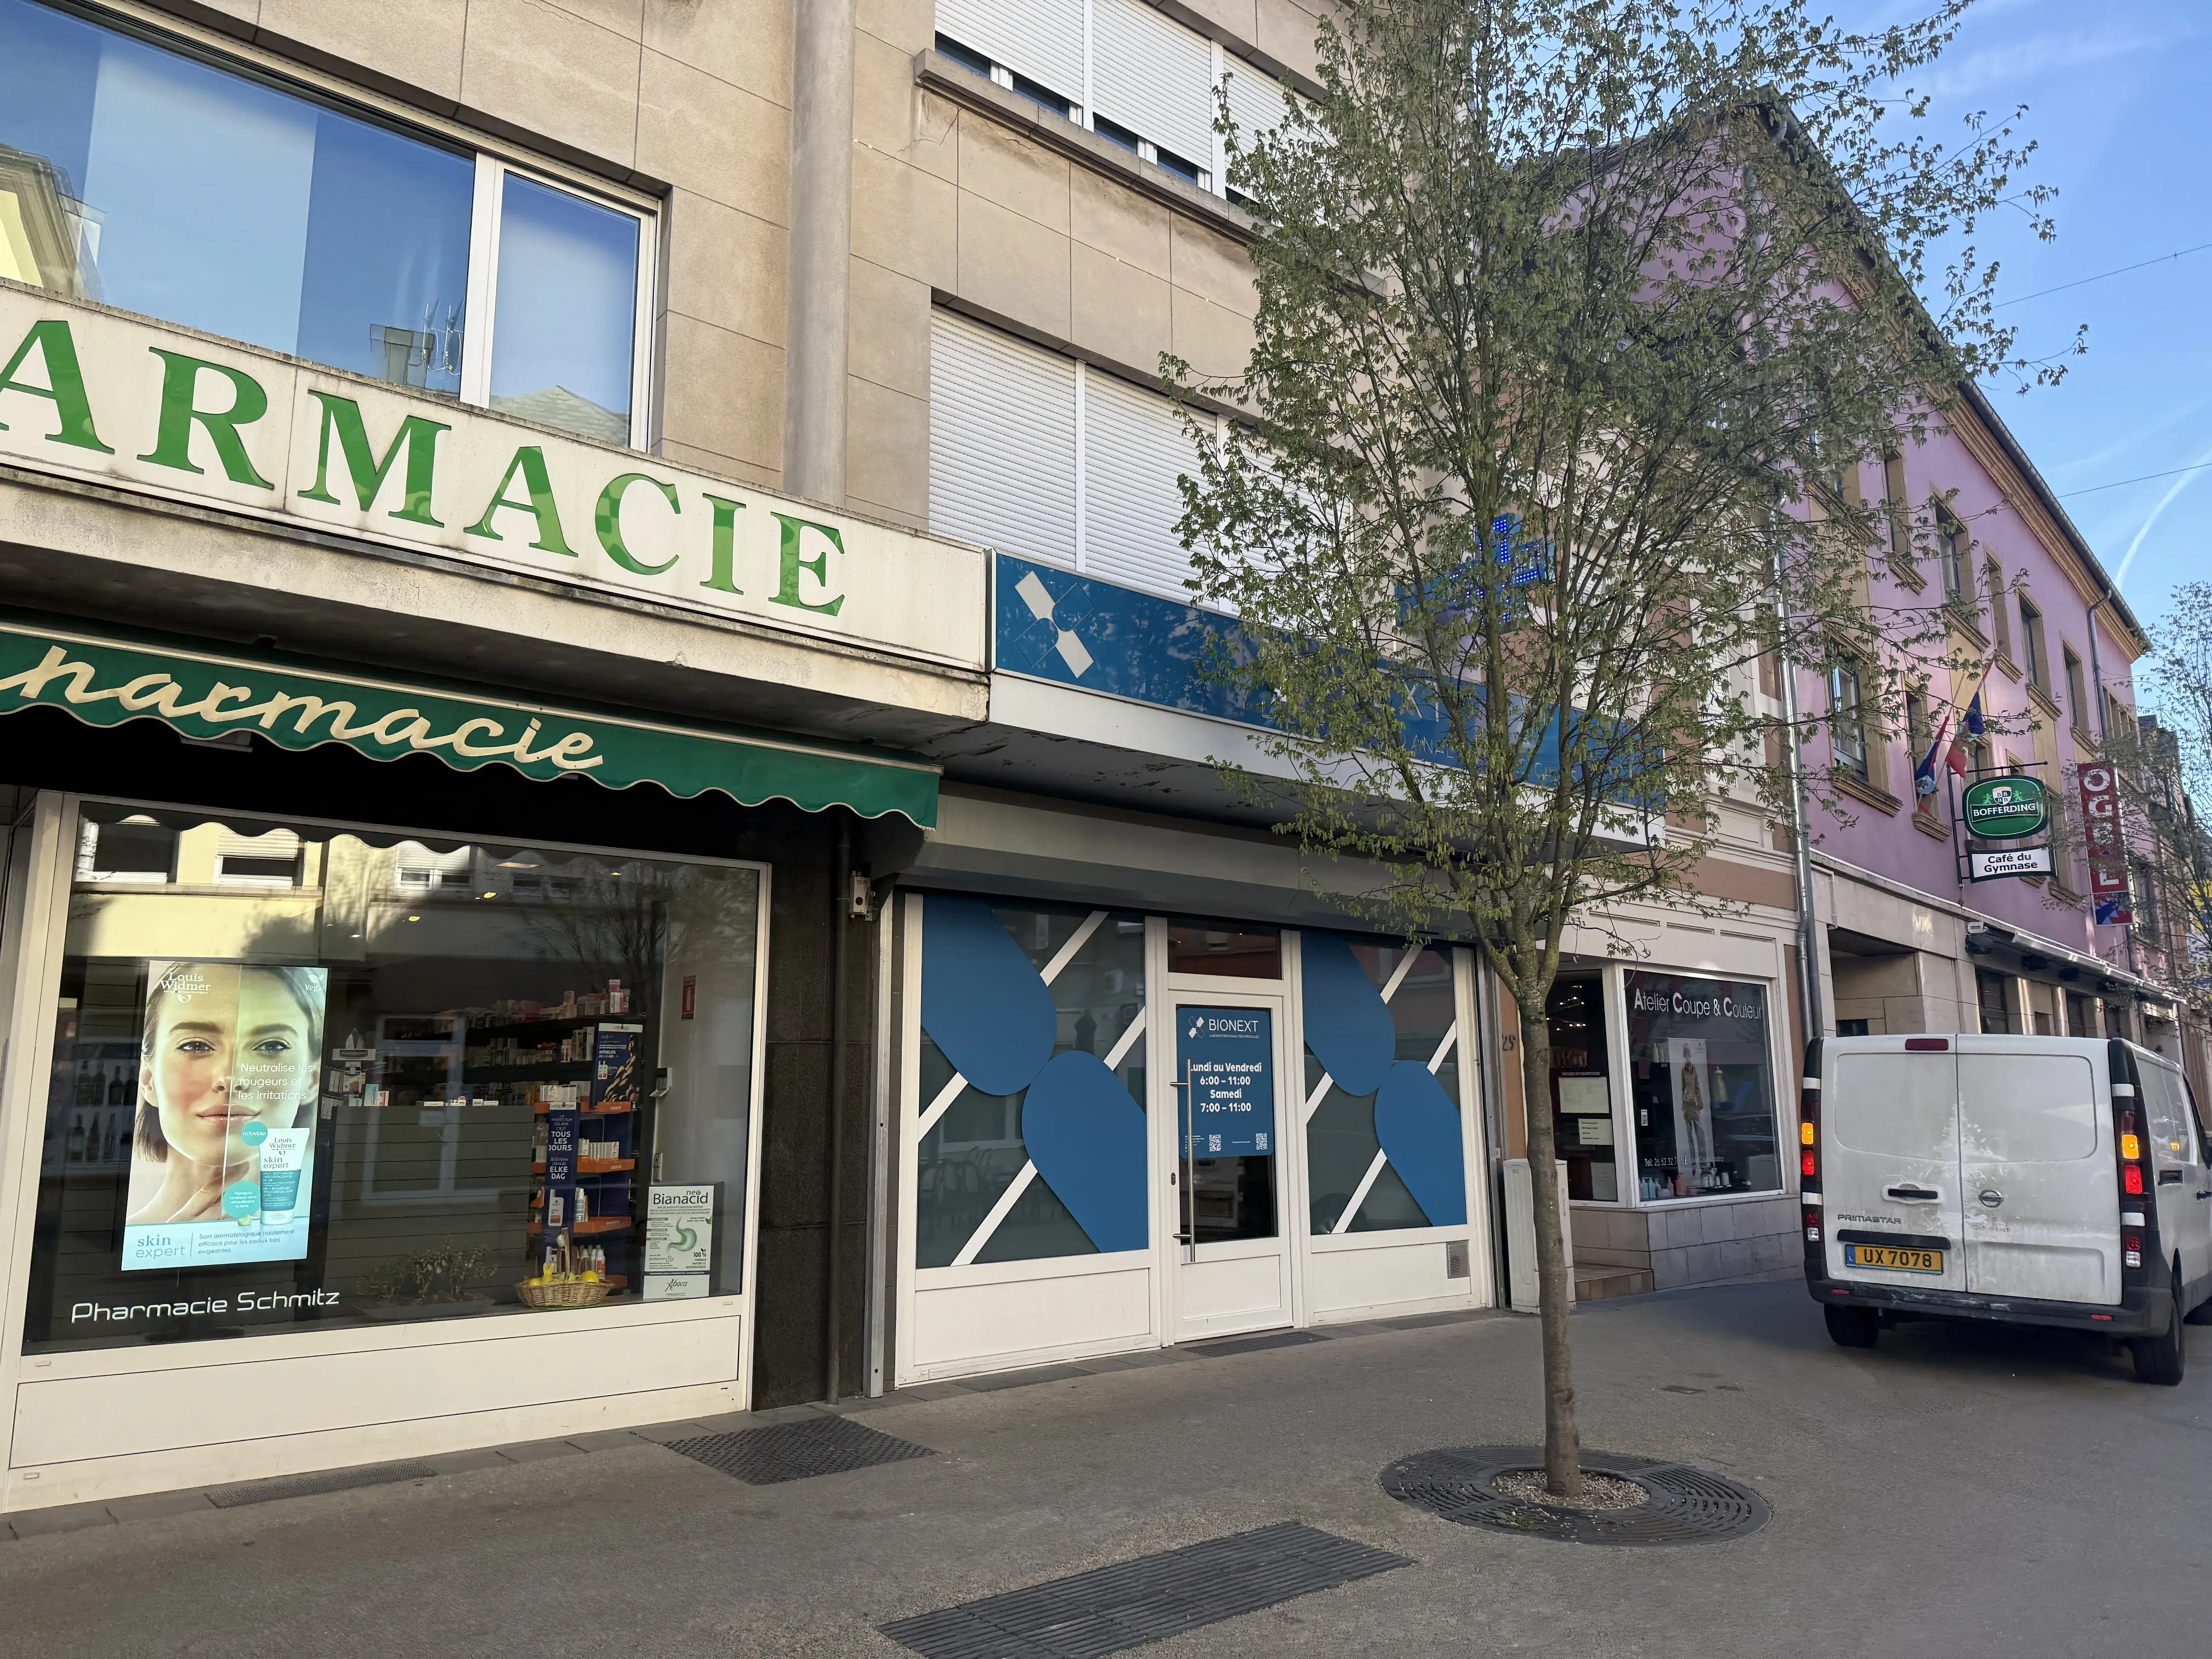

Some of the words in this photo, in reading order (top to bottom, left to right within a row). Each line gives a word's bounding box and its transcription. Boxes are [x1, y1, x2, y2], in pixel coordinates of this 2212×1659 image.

[1973, 804, 2035, 817] BOFFERDING
[1988, 854, 2013, 863] Café
[1984, 862, 2037, 873] Gymnase
[168, 972, 203, 982] Louis
[160, 981, 211, 991] Widmer
[1634, 989, 1669, 1012] Atelier
[1673, 992, 1710, 1018] Coupe
[1714, 999, 1721, 1015] &
[1724, 997, 1761, 1019] Couleur
[1209, 1019, 1258, 1032] BIONEXT
[241, 1063, 295, 1072] Neutralise
[299, 1063, 313, 1072] les
[1225, 1062, 1262, 1072] Vendredi
[240, 1079, 287, 1088] rougeurs
[1200, 1076, 1219, 1085] 6:00
[1228, 1077, 1251, 1085] 11:00
[239, 1091, 253, 1099] les
[257, 1091, 306, 1099] irritations
[1210, 1089, 1242, 1099] Samedi
[1200, 1103, 1220, 1112] 7:00
[1229, 1103, 1251, 1112] 11:00
[653, 1192, 708, 1204] Bianacid
[1838, 1214, 1901, 1224] PRIMASTAR
[137, 1235, 171, 1247] skin
[136, 1245, 185, 1259] expert
[1864, 1248, 1884, 1264] UX
[1889, 1250, 1932, 1268] 7078
[665, 1278, 688, 1291] Aboca
[71, 1297, 227, 1323] Pharmacie
[237, 1288, 340, 1312] Schmitz
